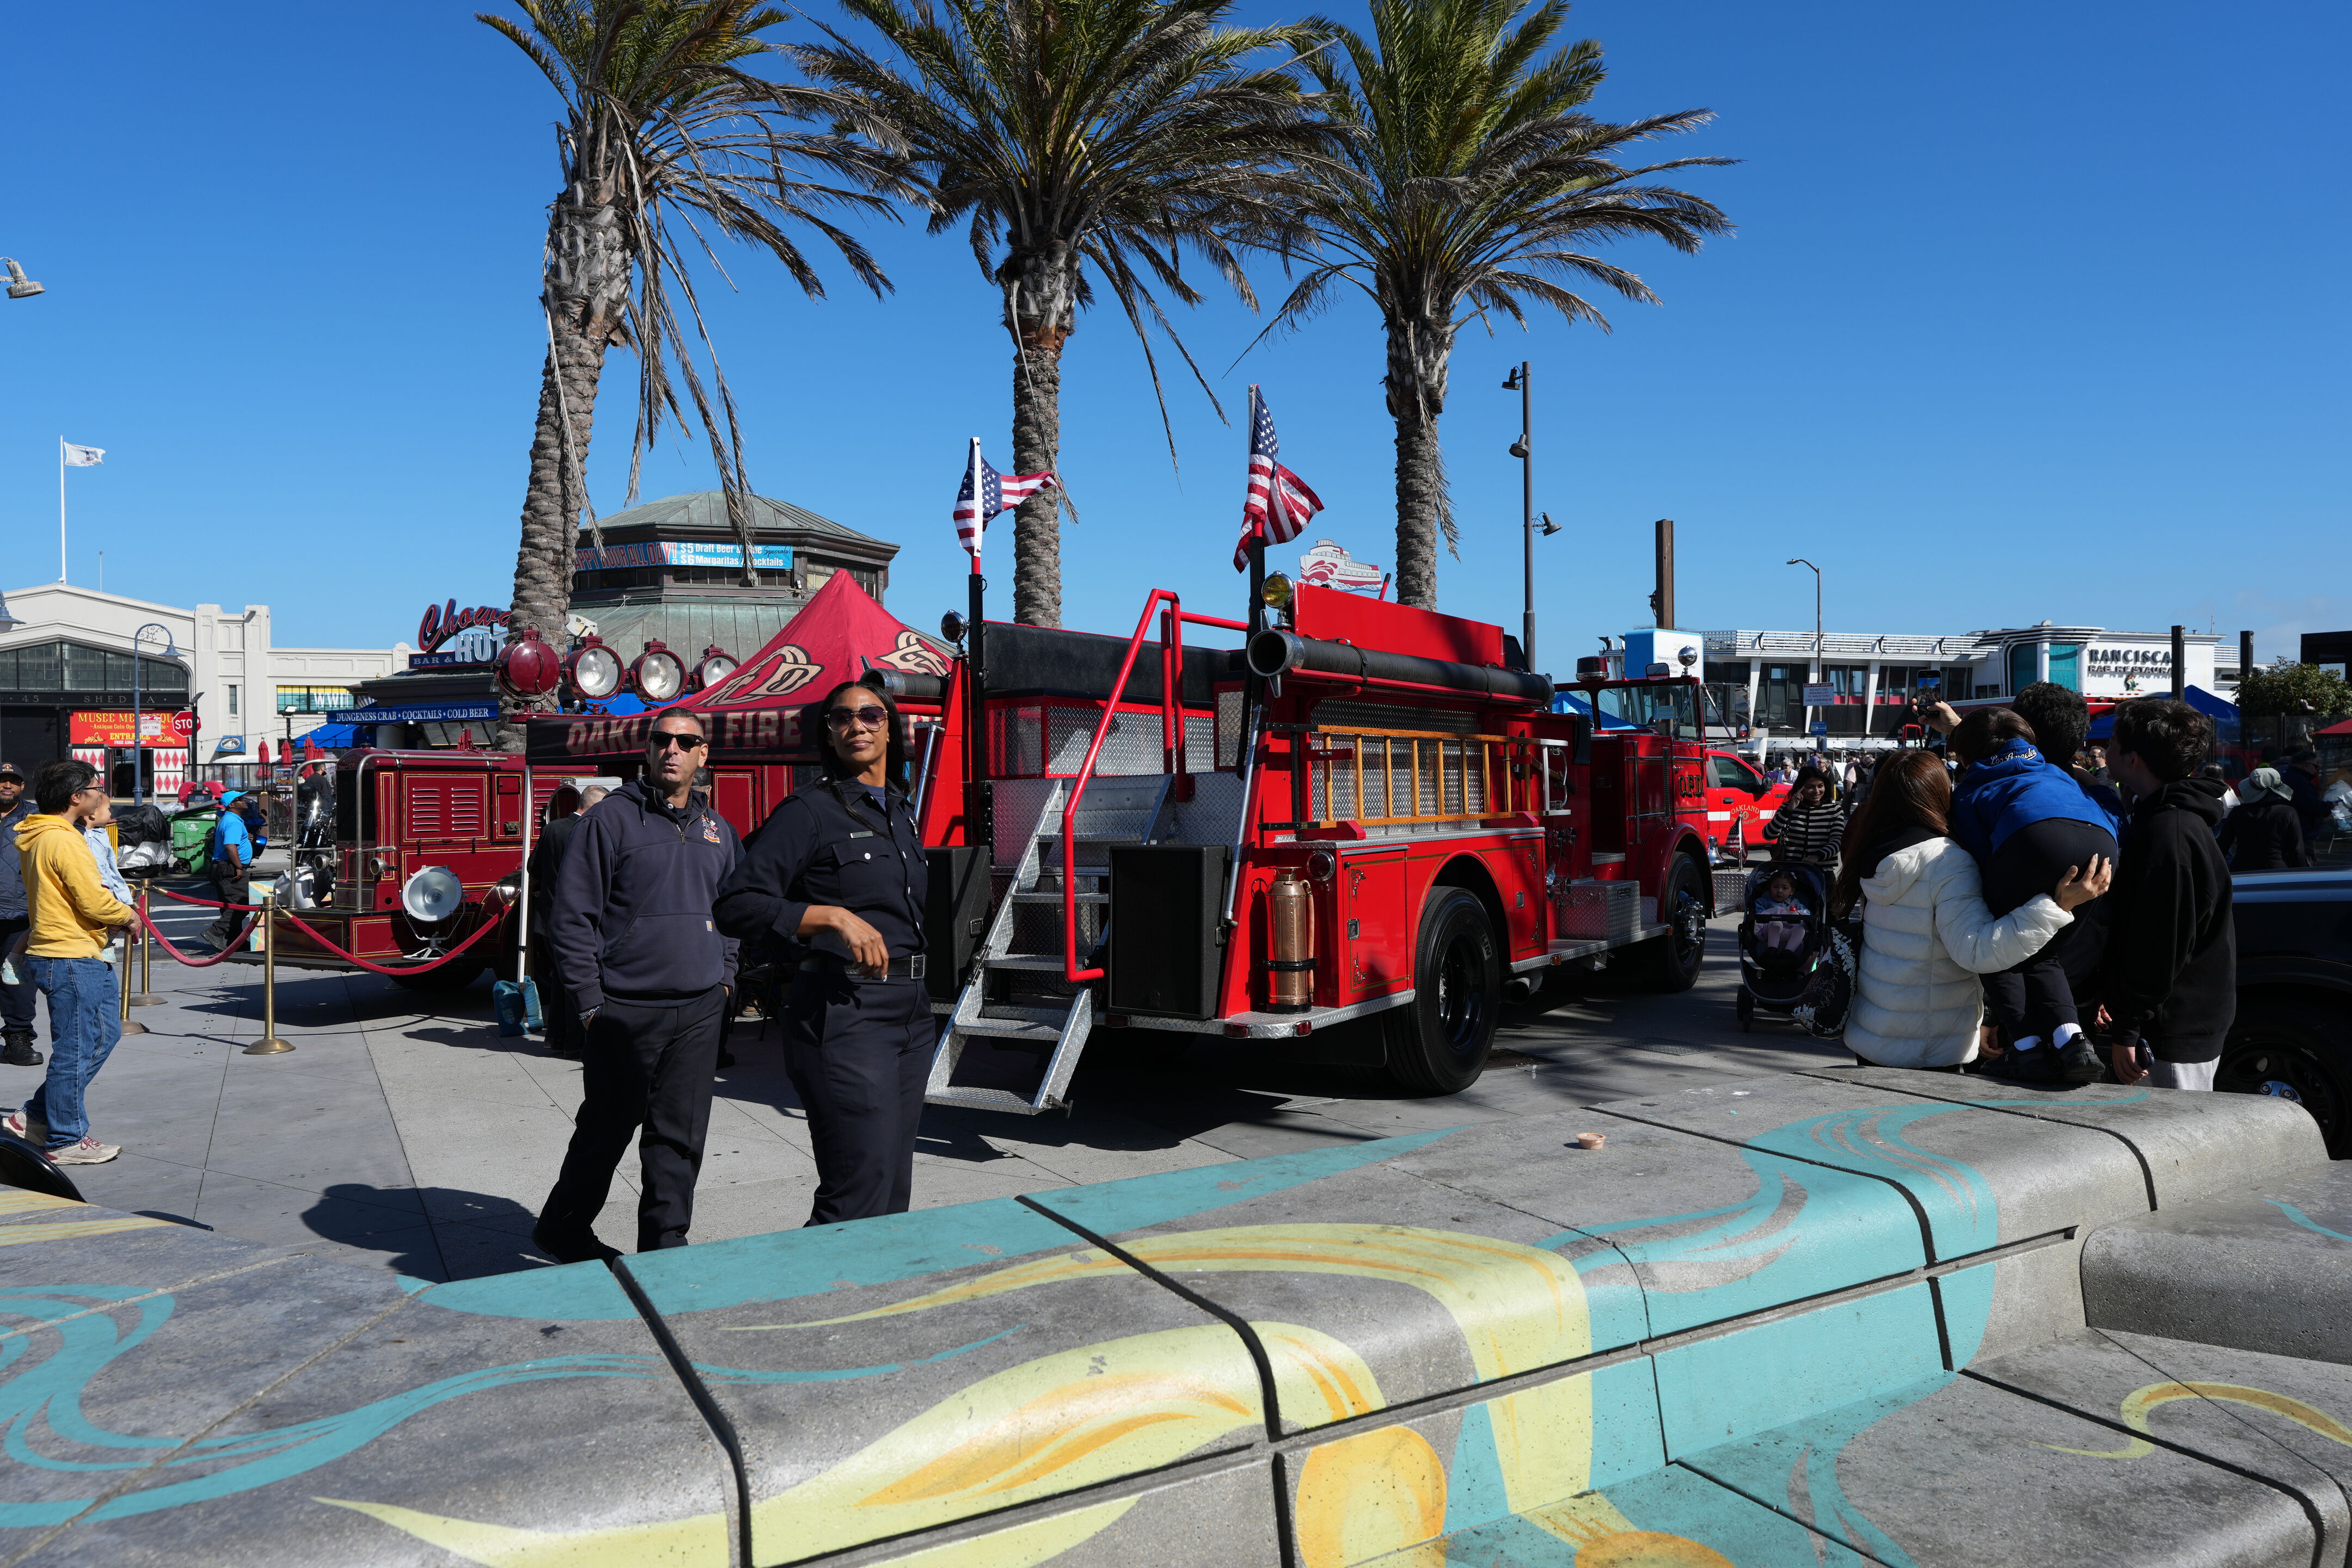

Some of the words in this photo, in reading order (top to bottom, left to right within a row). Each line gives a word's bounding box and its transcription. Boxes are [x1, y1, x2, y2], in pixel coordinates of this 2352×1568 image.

[574, 548, 599, 571] APPY
[627, 544, 648, 566] ALL
[646, 542, 677, 566] DAY!
[680, 543, 694, 554] $5
[695, 544, 714, 553] Draft
[716, 544, 734, 553] Beer
[763, 546, 792, 558] Specials!
[680, 554, 695, 565] $6
[695, 555, 739, 566] Margaritas
[752, 558, 783, 566] ocktails
[418, 598, 512, 652] Chow
[454, 631, 509, 663] HUT
[2088, 648, 2172, 664] RANCISCA
[84, 695, 126, 703] SHED
[78, 713, 115, 722] MUSEE
[336, 712, 377, 722] DUNGENESS
[378, 711, 396, 720] CRAB
[402, 709, 442, 720] COCKTAILS
[447, 708, 468, 718] COLD
[469, 708, 489, 718] BEER
[566, 712, 714, 756] OAKLD
[723, 709, 804, 750] FIRE
[1990, 755, 2004, 765] Los
[1731, 804, 1760, 814] OAKLAND
[1742, 816, 1759, 825] EPARTMENT
